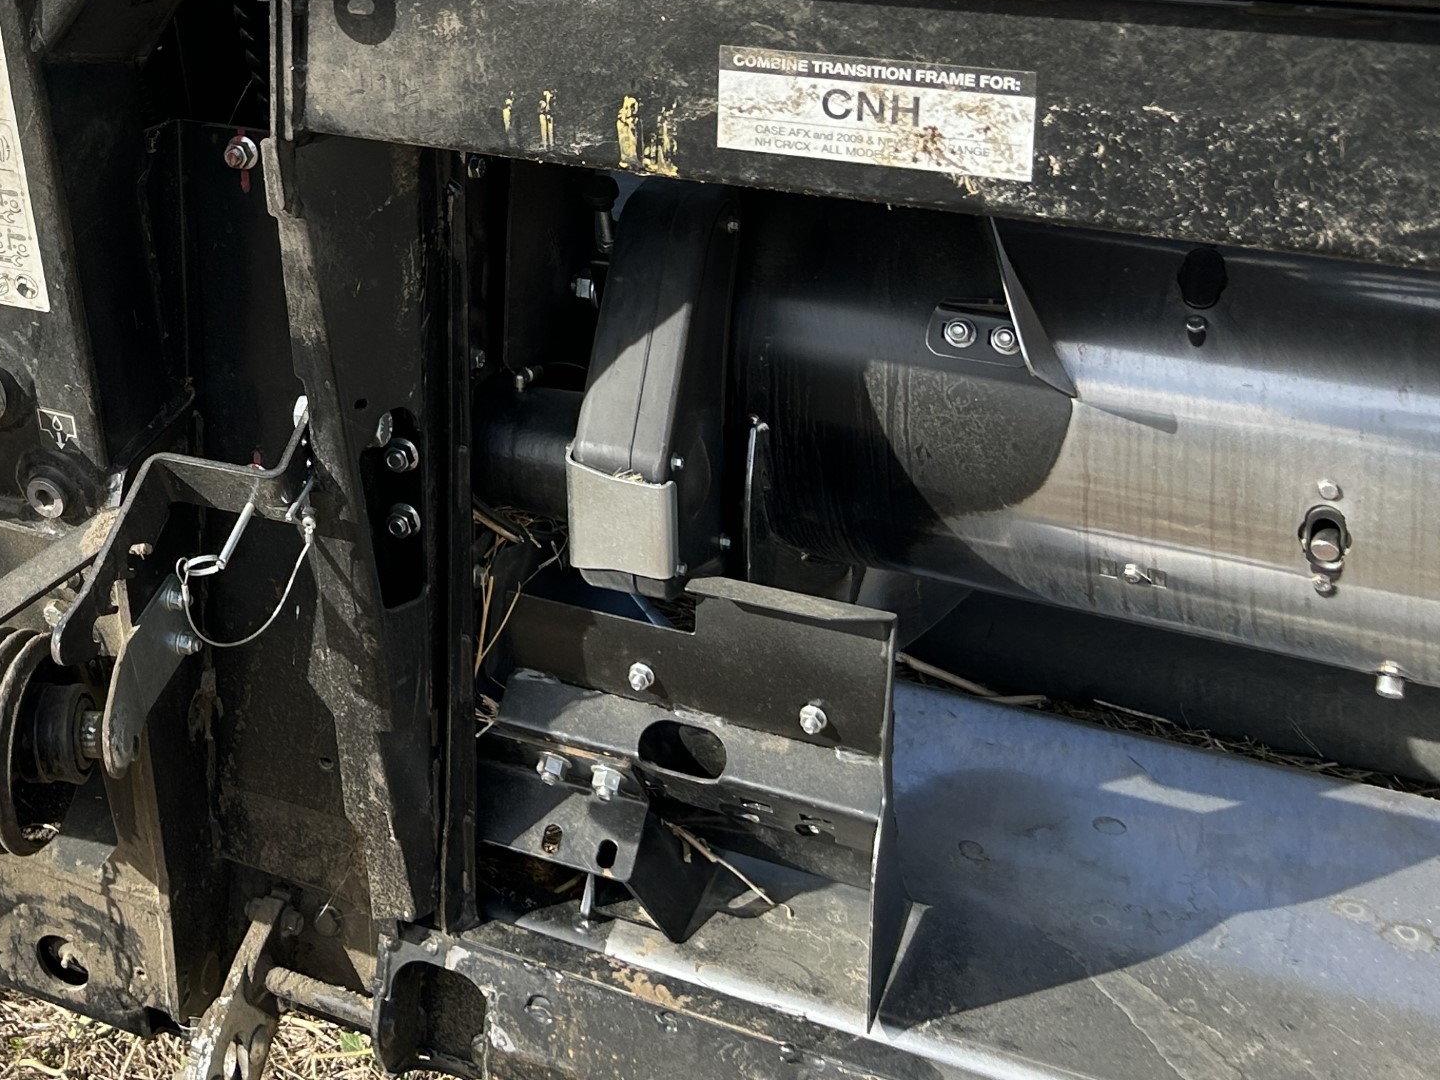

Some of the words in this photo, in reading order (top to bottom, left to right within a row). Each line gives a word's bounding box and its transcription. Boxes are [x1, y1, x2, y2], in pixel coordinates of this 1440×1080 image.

[733, 54, 809, 73] COMBINE
[811, 60, 912, 81] TRANSITION
[915, 69, 976, 87] FRAME
[979, 74, 1021, 92] FOR:
[821, 88, 921, 127] CNH
[754, 124, 786, 136] CASE
[787, 128, 812, 139] AFX
[813, 132, 834, 141] and
[865, 136, 874, 146] &
[754, 137, 772, 147] NH
[774, 139, 812, 152] CR/CX
[821, 144, 843, 155] ALL
